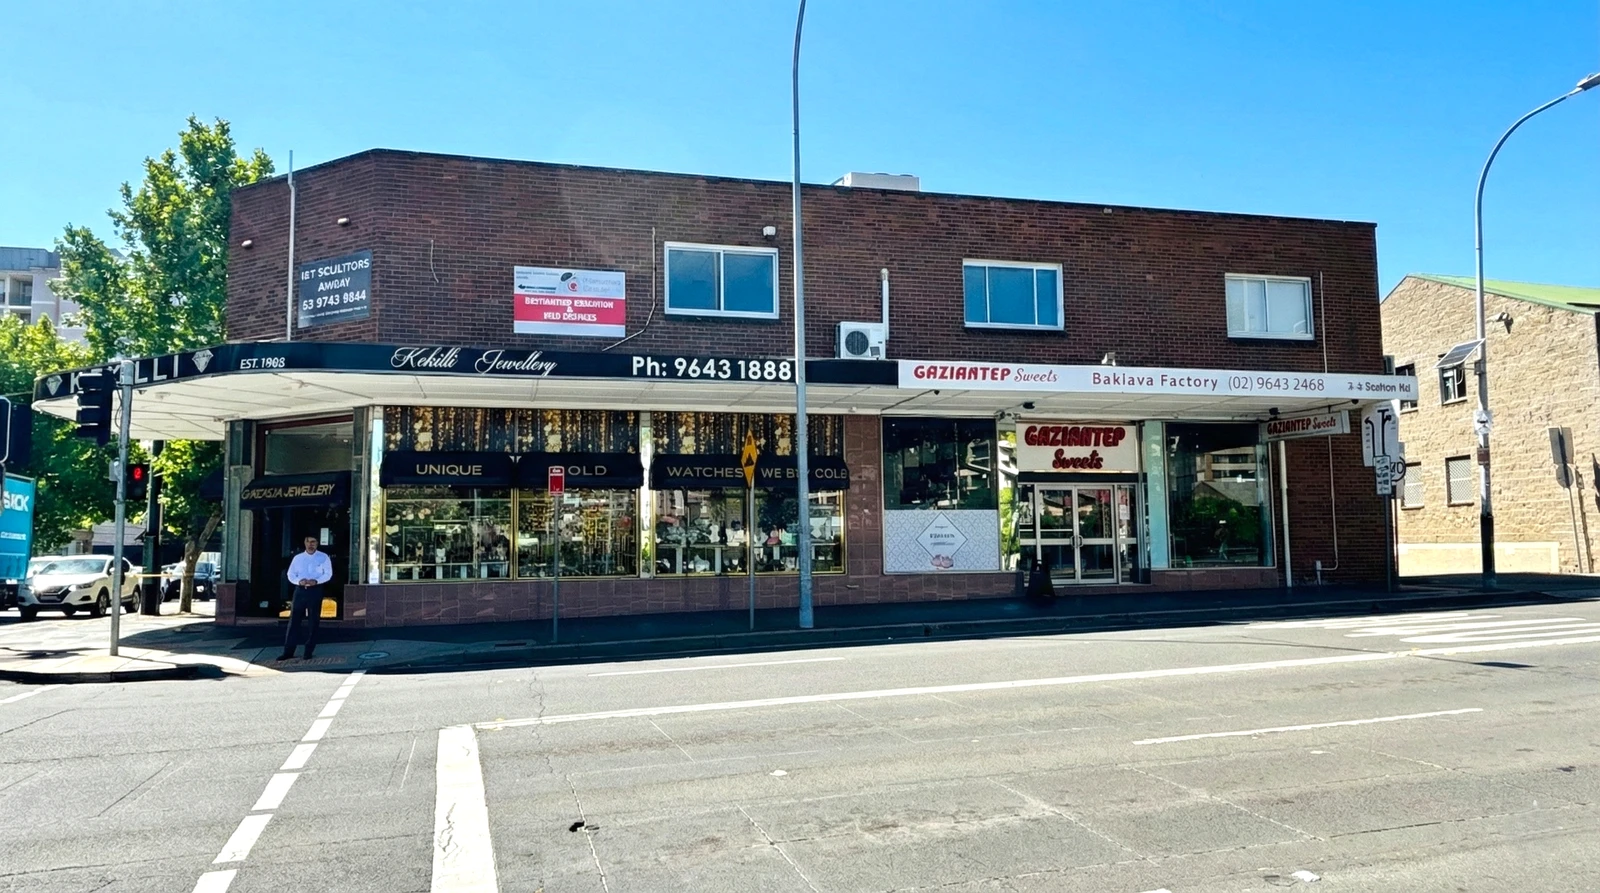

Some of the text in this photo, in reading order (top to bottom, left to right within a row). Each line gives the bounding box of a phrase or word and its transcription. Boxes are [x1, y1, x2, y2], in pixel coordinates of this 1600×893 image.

[316, 294, 340, 309] 9743
[240, 358, 259, 369] EST.
[390, 346, 558, 377] Kekilli Jewellery
[632, 356, 792, 380] Ph: 9643 1888
[913, 365, 1058, 383] GAZIANTEP Sweets
[1092, 372, 1325, 391] Baklava Factory (02) 9643 2468
[1267, 418, 1312, 435] GAZIANTEP
[1025, 425, 1126, 447] GAZIANTEP
[1052, 448, 1104, 469] Sweets
[416, 464, 482, 476] UNIQUE
[567, 465, 607, 476] OLD
[667, 466, 744, 478] WATCHES
[761, 467, 782, 478] WE
[283, 484, 335, 498] JEWELLERY
